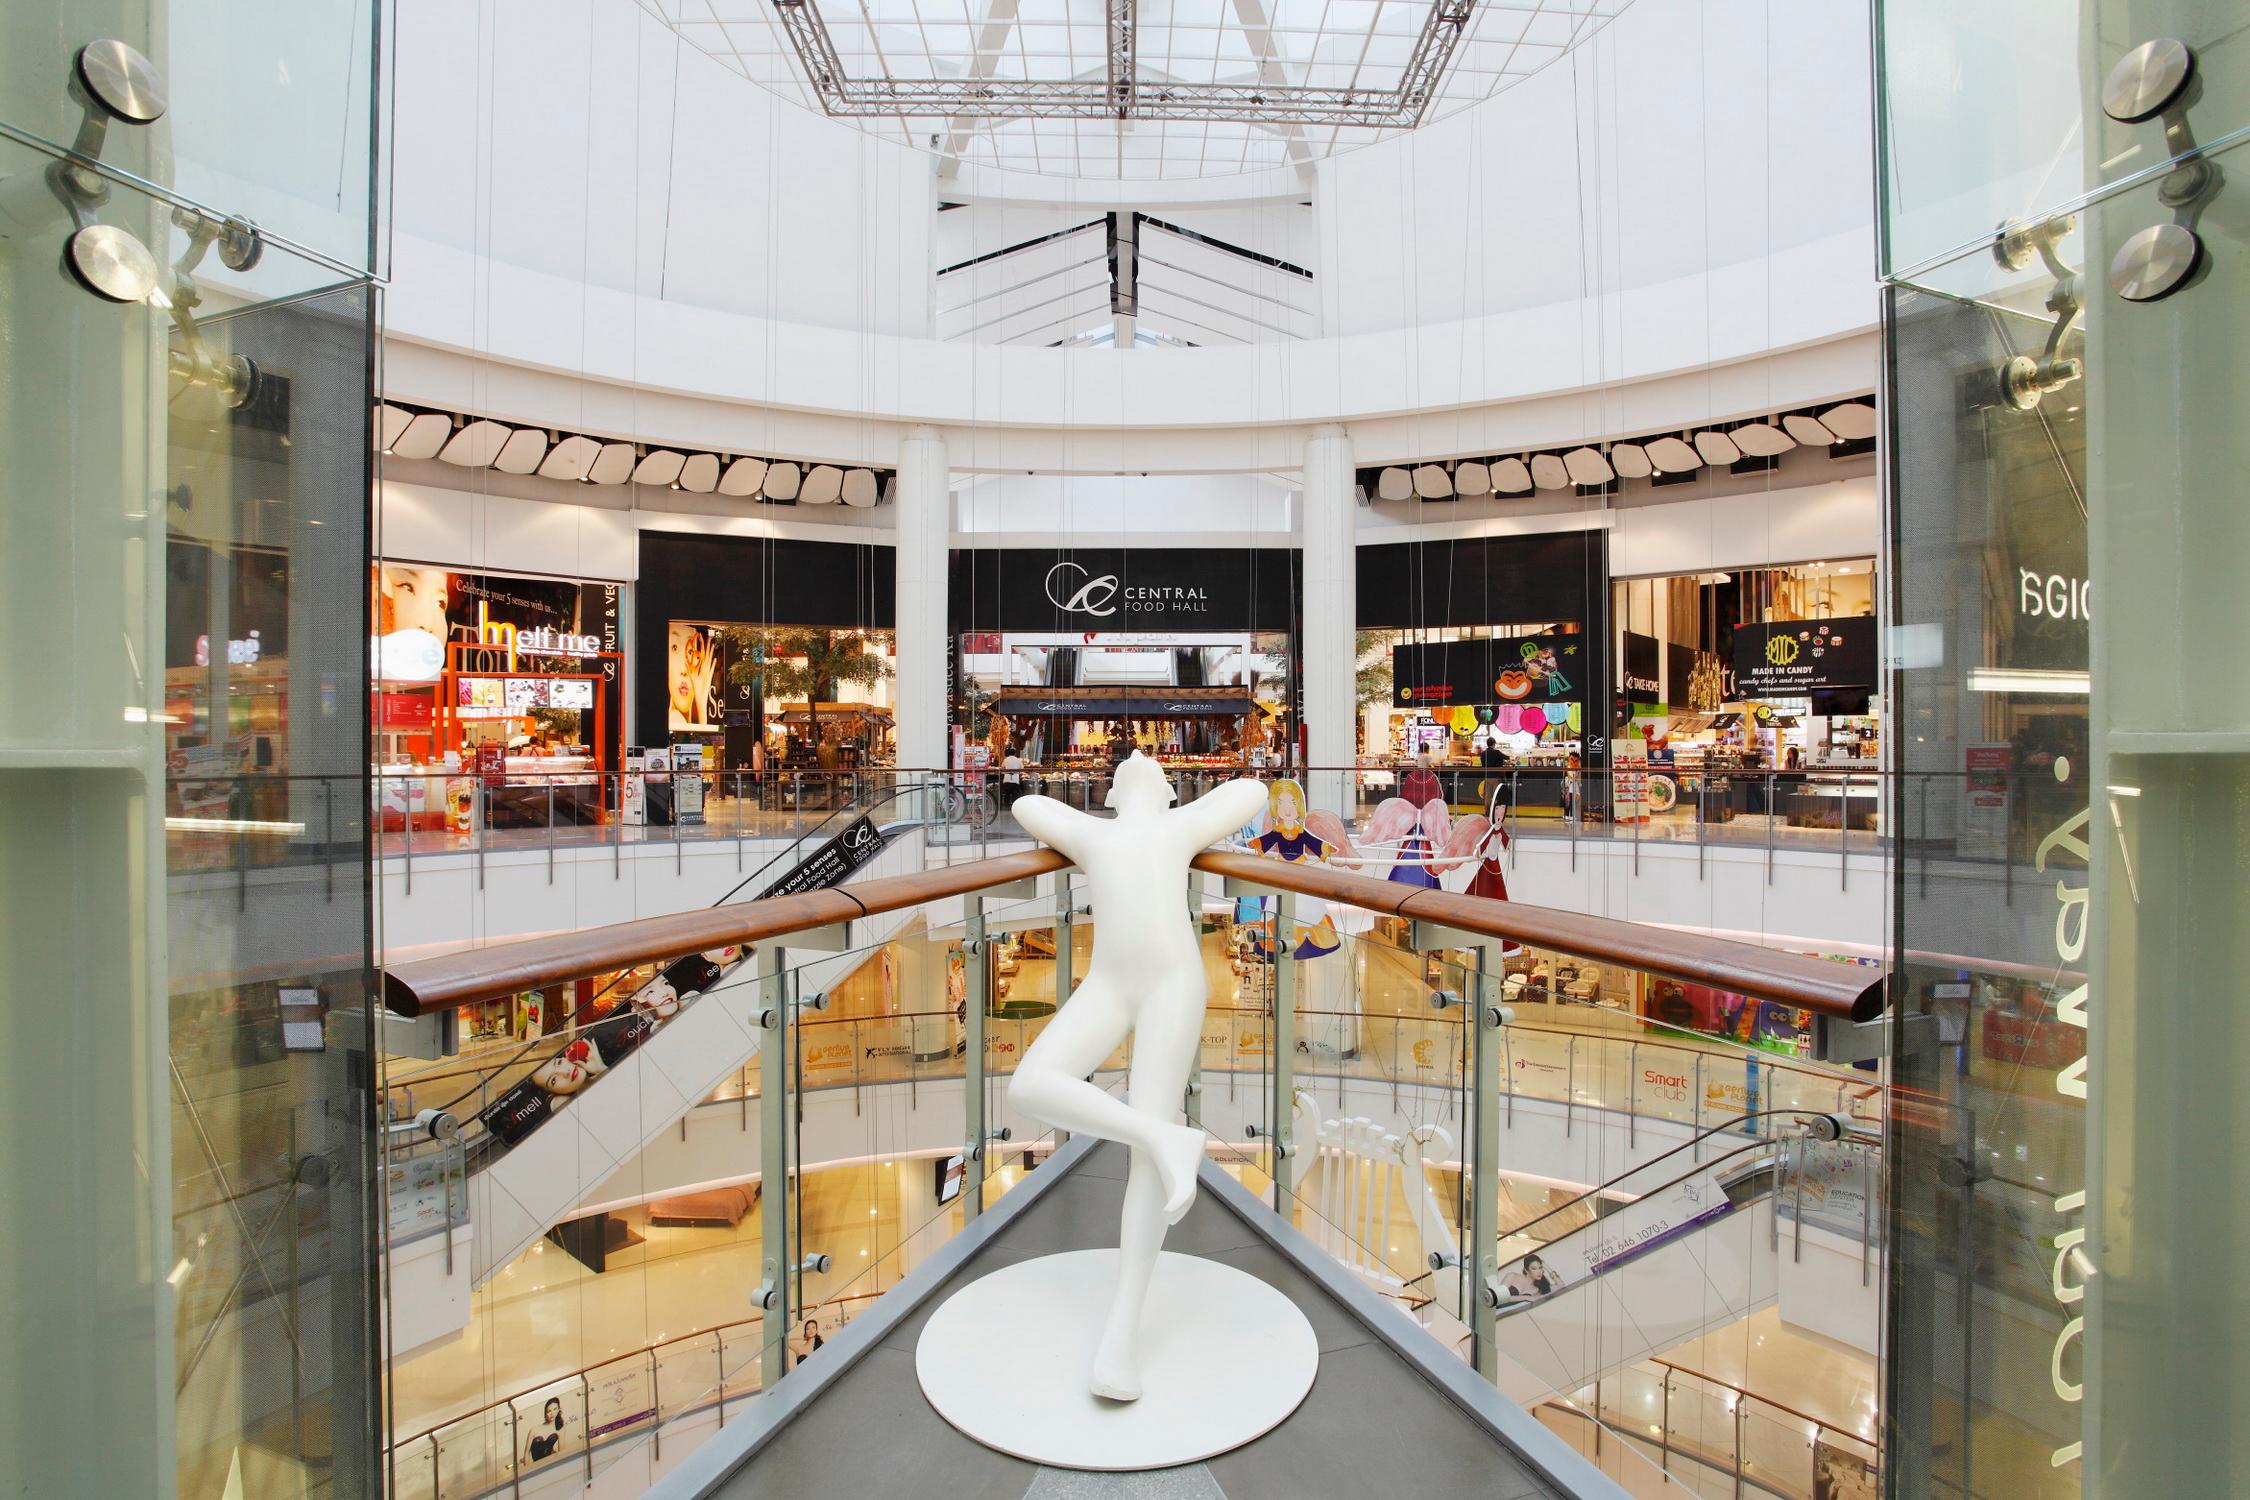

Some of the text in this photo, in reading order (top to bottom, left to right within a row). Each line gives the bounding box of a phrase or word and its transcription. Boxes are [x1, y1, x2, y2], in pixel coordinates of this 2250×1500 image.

[456, 579, 490, 598] Celebrate
[490, 591, 506, 602] your
[506, 592, 511, 605] 5
[511, 597, 530, 608] senses
[530, 599, 544, 611] with
[1124, 587, 1208, 600] CENTRAL
[1124, 601, 1208, 612] FOOD HALL
[479, 601, 601, 672] melt me
[1751, 666, 1813, 676] MADE IN CANDY
[1633, 677, 1659, 693] TAKE HOME
[1739, 678, 1759, 686] candy
[1779, 676, 1793, 684] and
[1793, 677, 1814, 686] sugar
[853, 836, 881, 859] CENTRAL
[855, 850, 870, 863] FOOD
[785, 873, 805, 892] your
[803, 867, 810, 876] 5
[810, 848, 837, 871] senses
[806, 868, 826, 886] Food
[825, 857, 841, 871] Hall
[826, 862, 847, 882] Zone)
[1645, 1070, 1688, 1088] Smart
[1653, 1086, 1687, 1102] club
[1602, 1247, 1615, 1258] 02
[1617, 1236, 1635, 1251] 646
[1636, 1220, 1669, 1242] 1070-3
